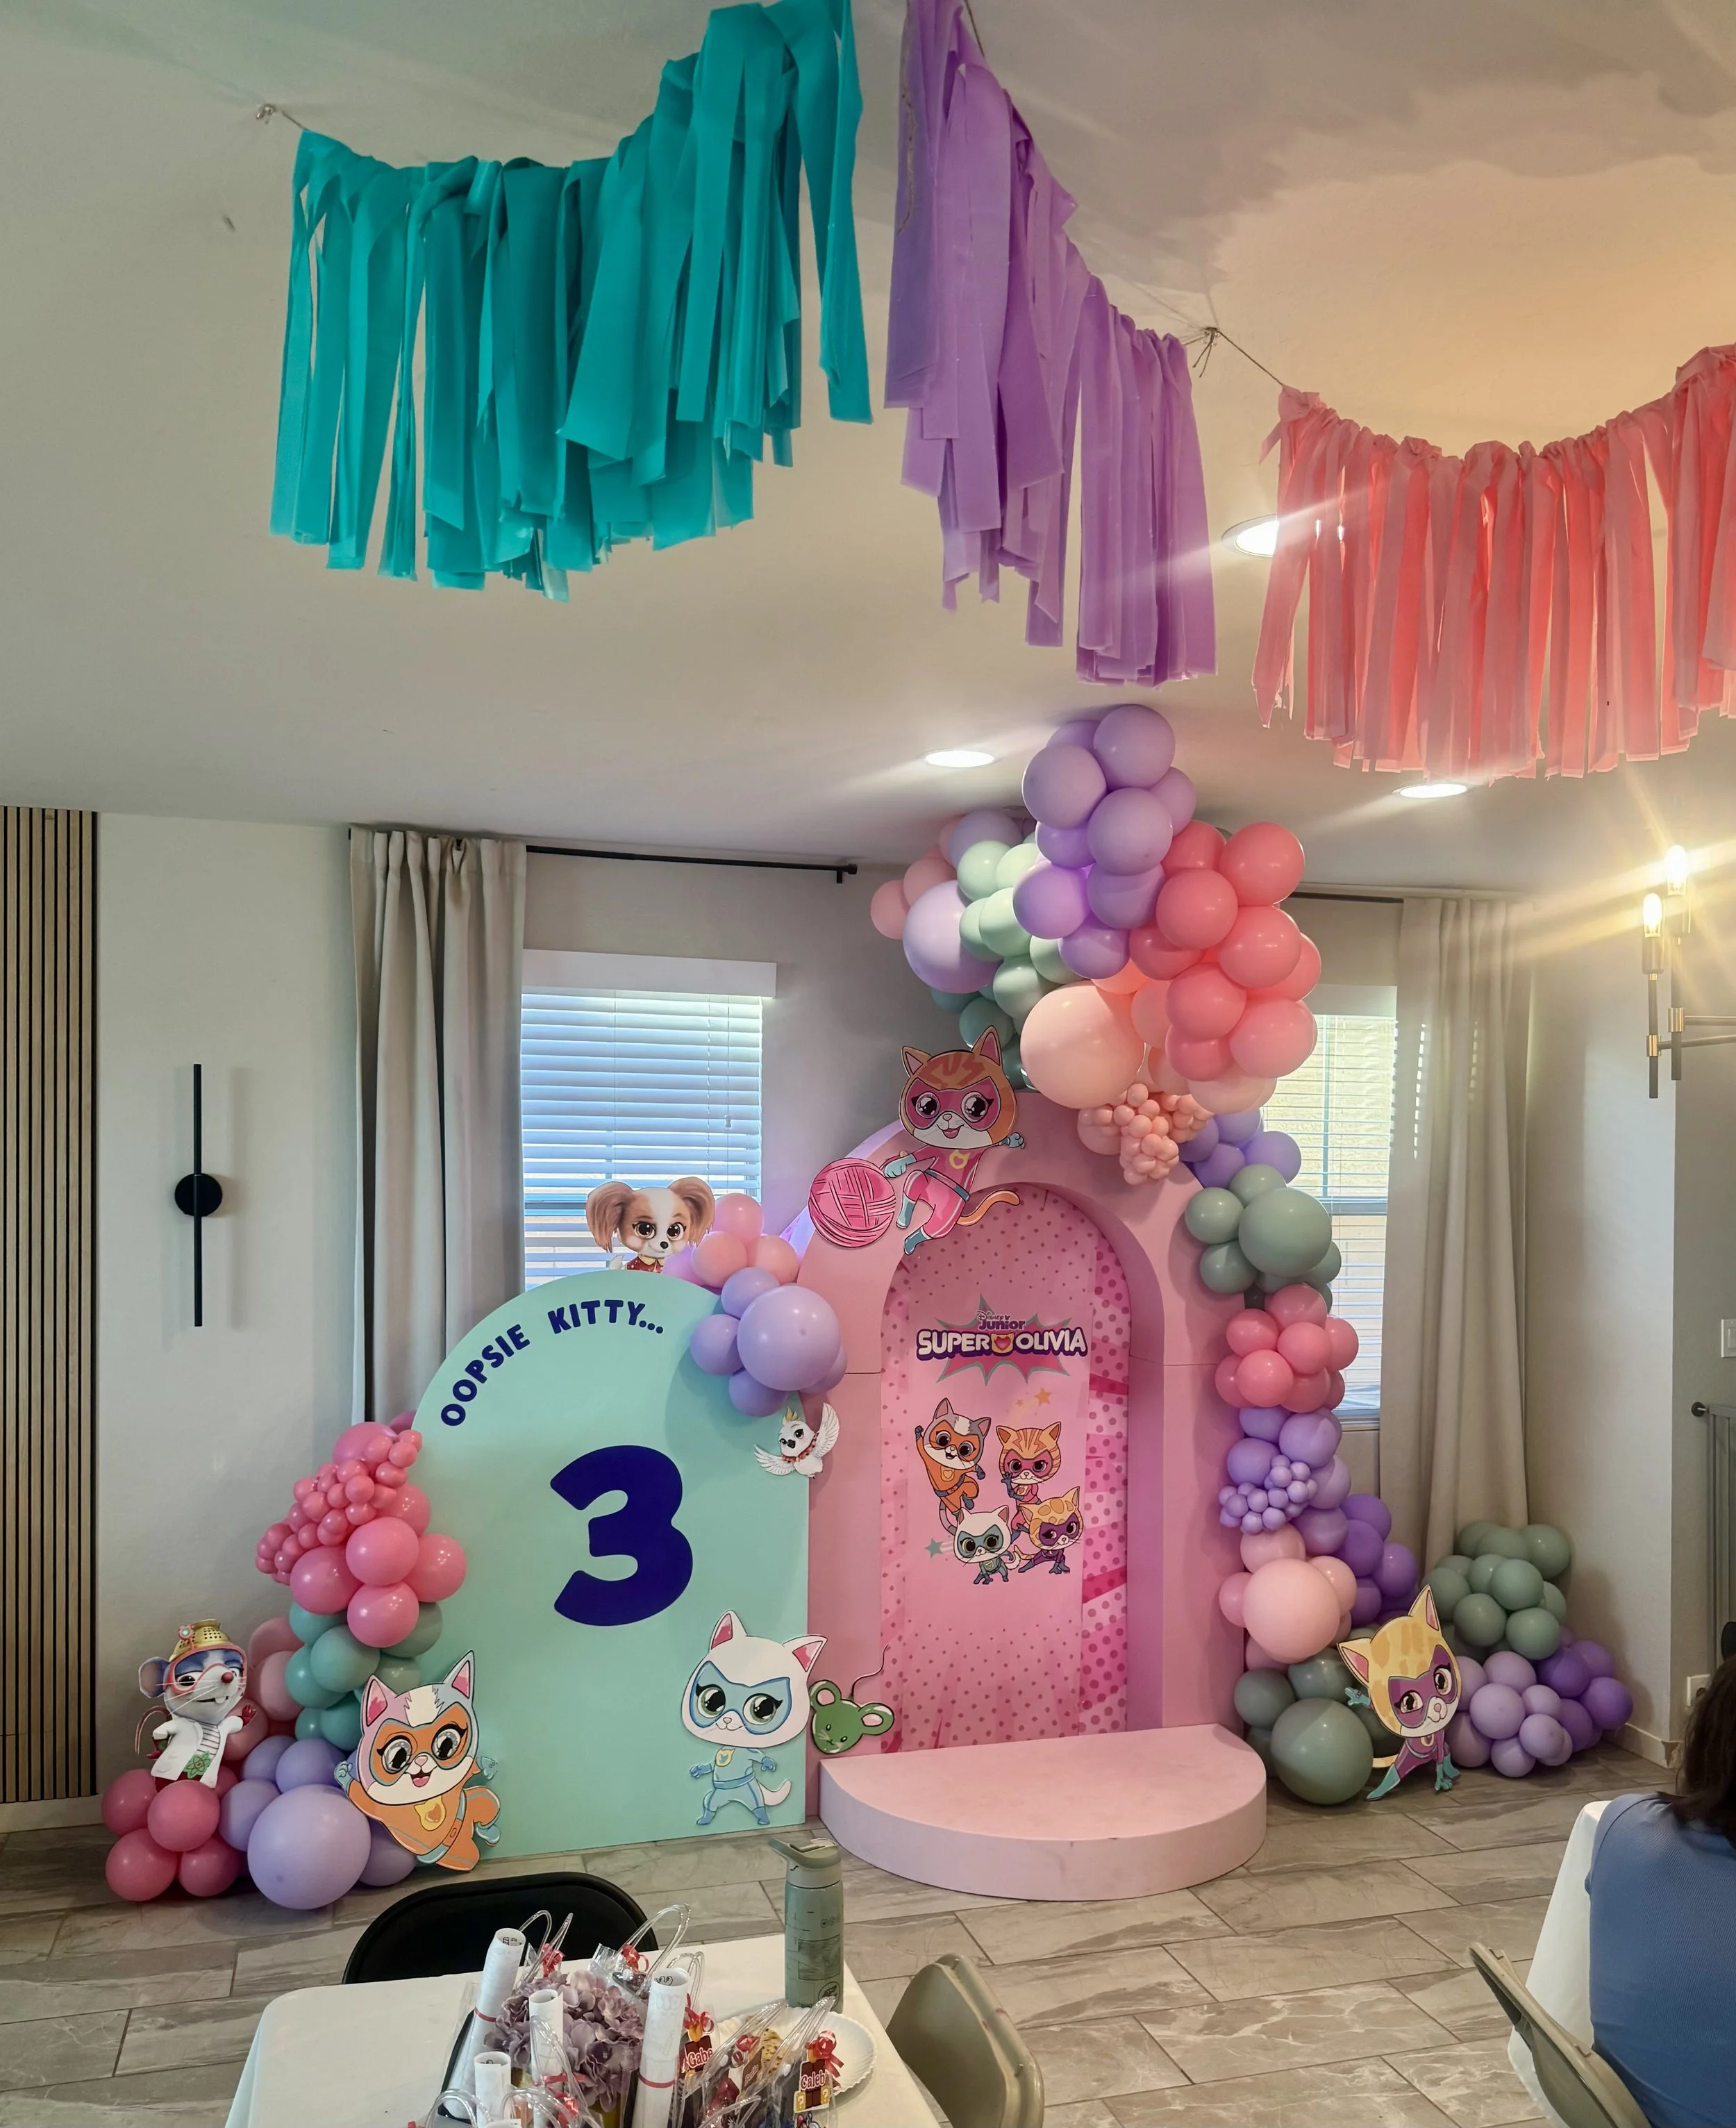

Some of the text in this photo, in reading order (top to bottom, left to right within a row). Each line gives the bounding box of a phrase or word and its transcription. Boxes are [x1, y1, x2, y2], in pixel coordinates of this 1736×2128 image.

[978, 1320, 1025, 1330] Junior
[917, 1329, 1087, 1356] SUPER OLIVIA
[441, 1299, 664, 1426] OOPSIE KITTY...
[551, 1445, 693, 1626] 3
[687, 2047, 712, 2068] Gabe
[801, 2070, 826, 2090] Caleb
